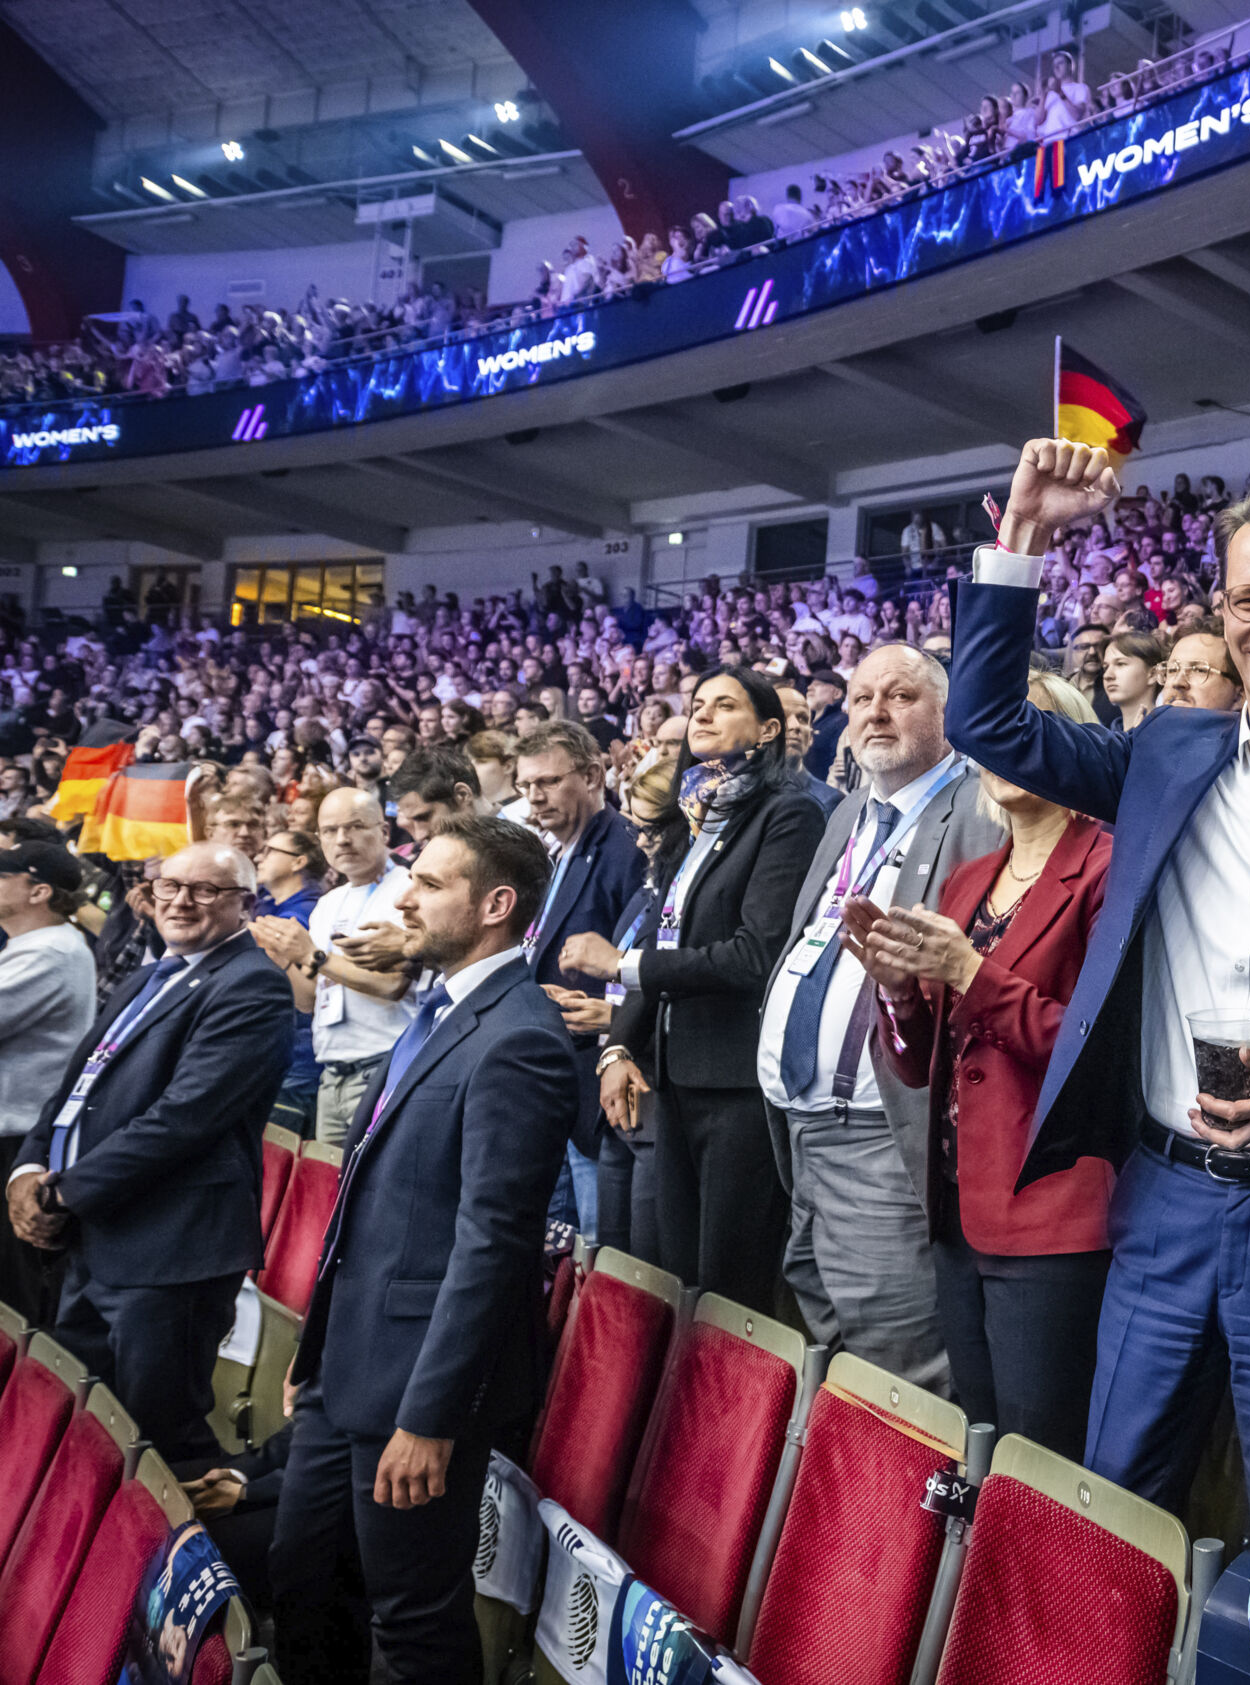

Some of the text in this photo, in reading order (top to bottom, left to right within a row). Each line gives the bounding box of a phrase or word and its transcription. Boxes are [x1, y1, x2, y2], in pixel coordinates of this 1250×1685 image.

[477, 331, 597, 376] WOMEN'S
[11, 423, 120, 449] WOMEN'S
[604, 541, 629, 554] 203
[1080, 1488, 1091, 1504] 119
